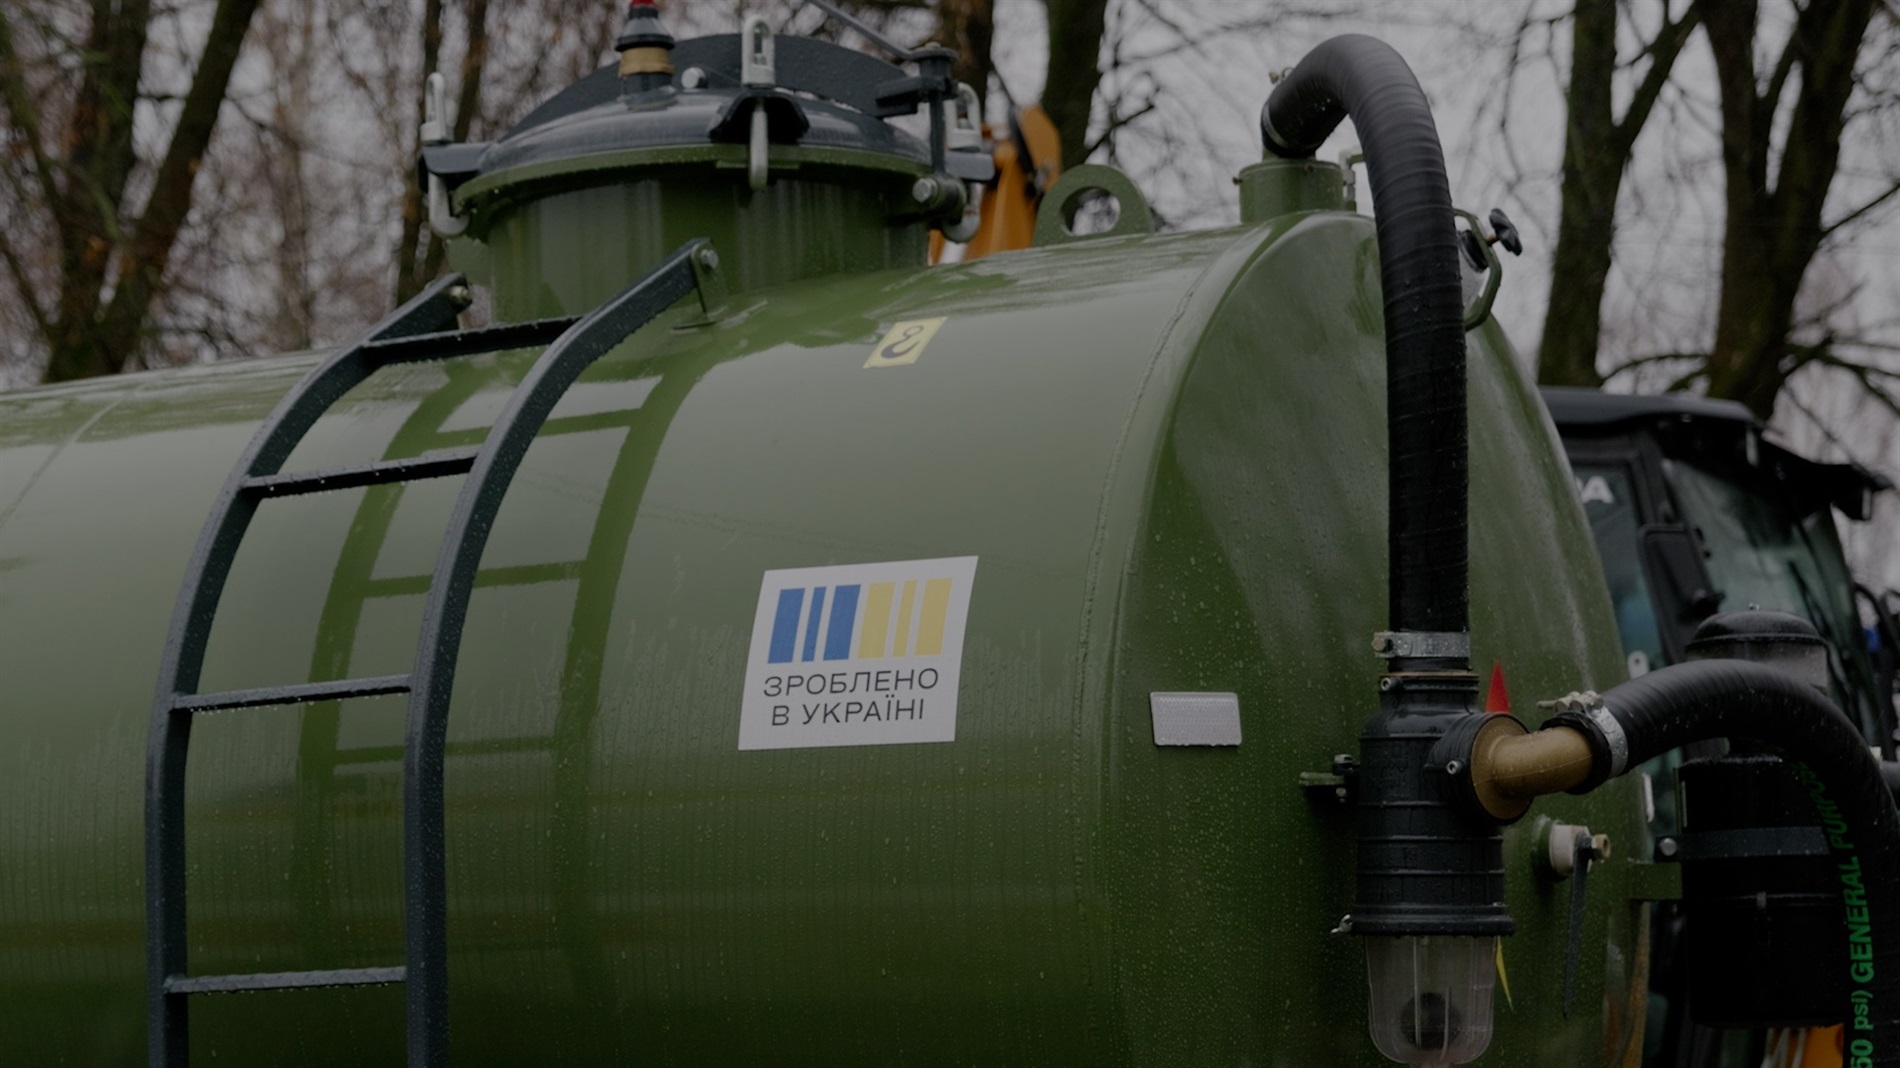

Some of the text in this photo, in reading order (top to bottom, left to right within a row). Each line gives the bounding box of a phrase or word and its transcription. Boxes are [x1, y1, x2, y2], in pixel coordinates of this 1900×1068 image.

[763, 668, 939, 697] ЗРОБЛЕНО
[772, 694, 924, 726] В УКРАЇНІ
[1839, 855, 1875, 983] GENERAL
[1851, 989, 1873, 1030] psi)
